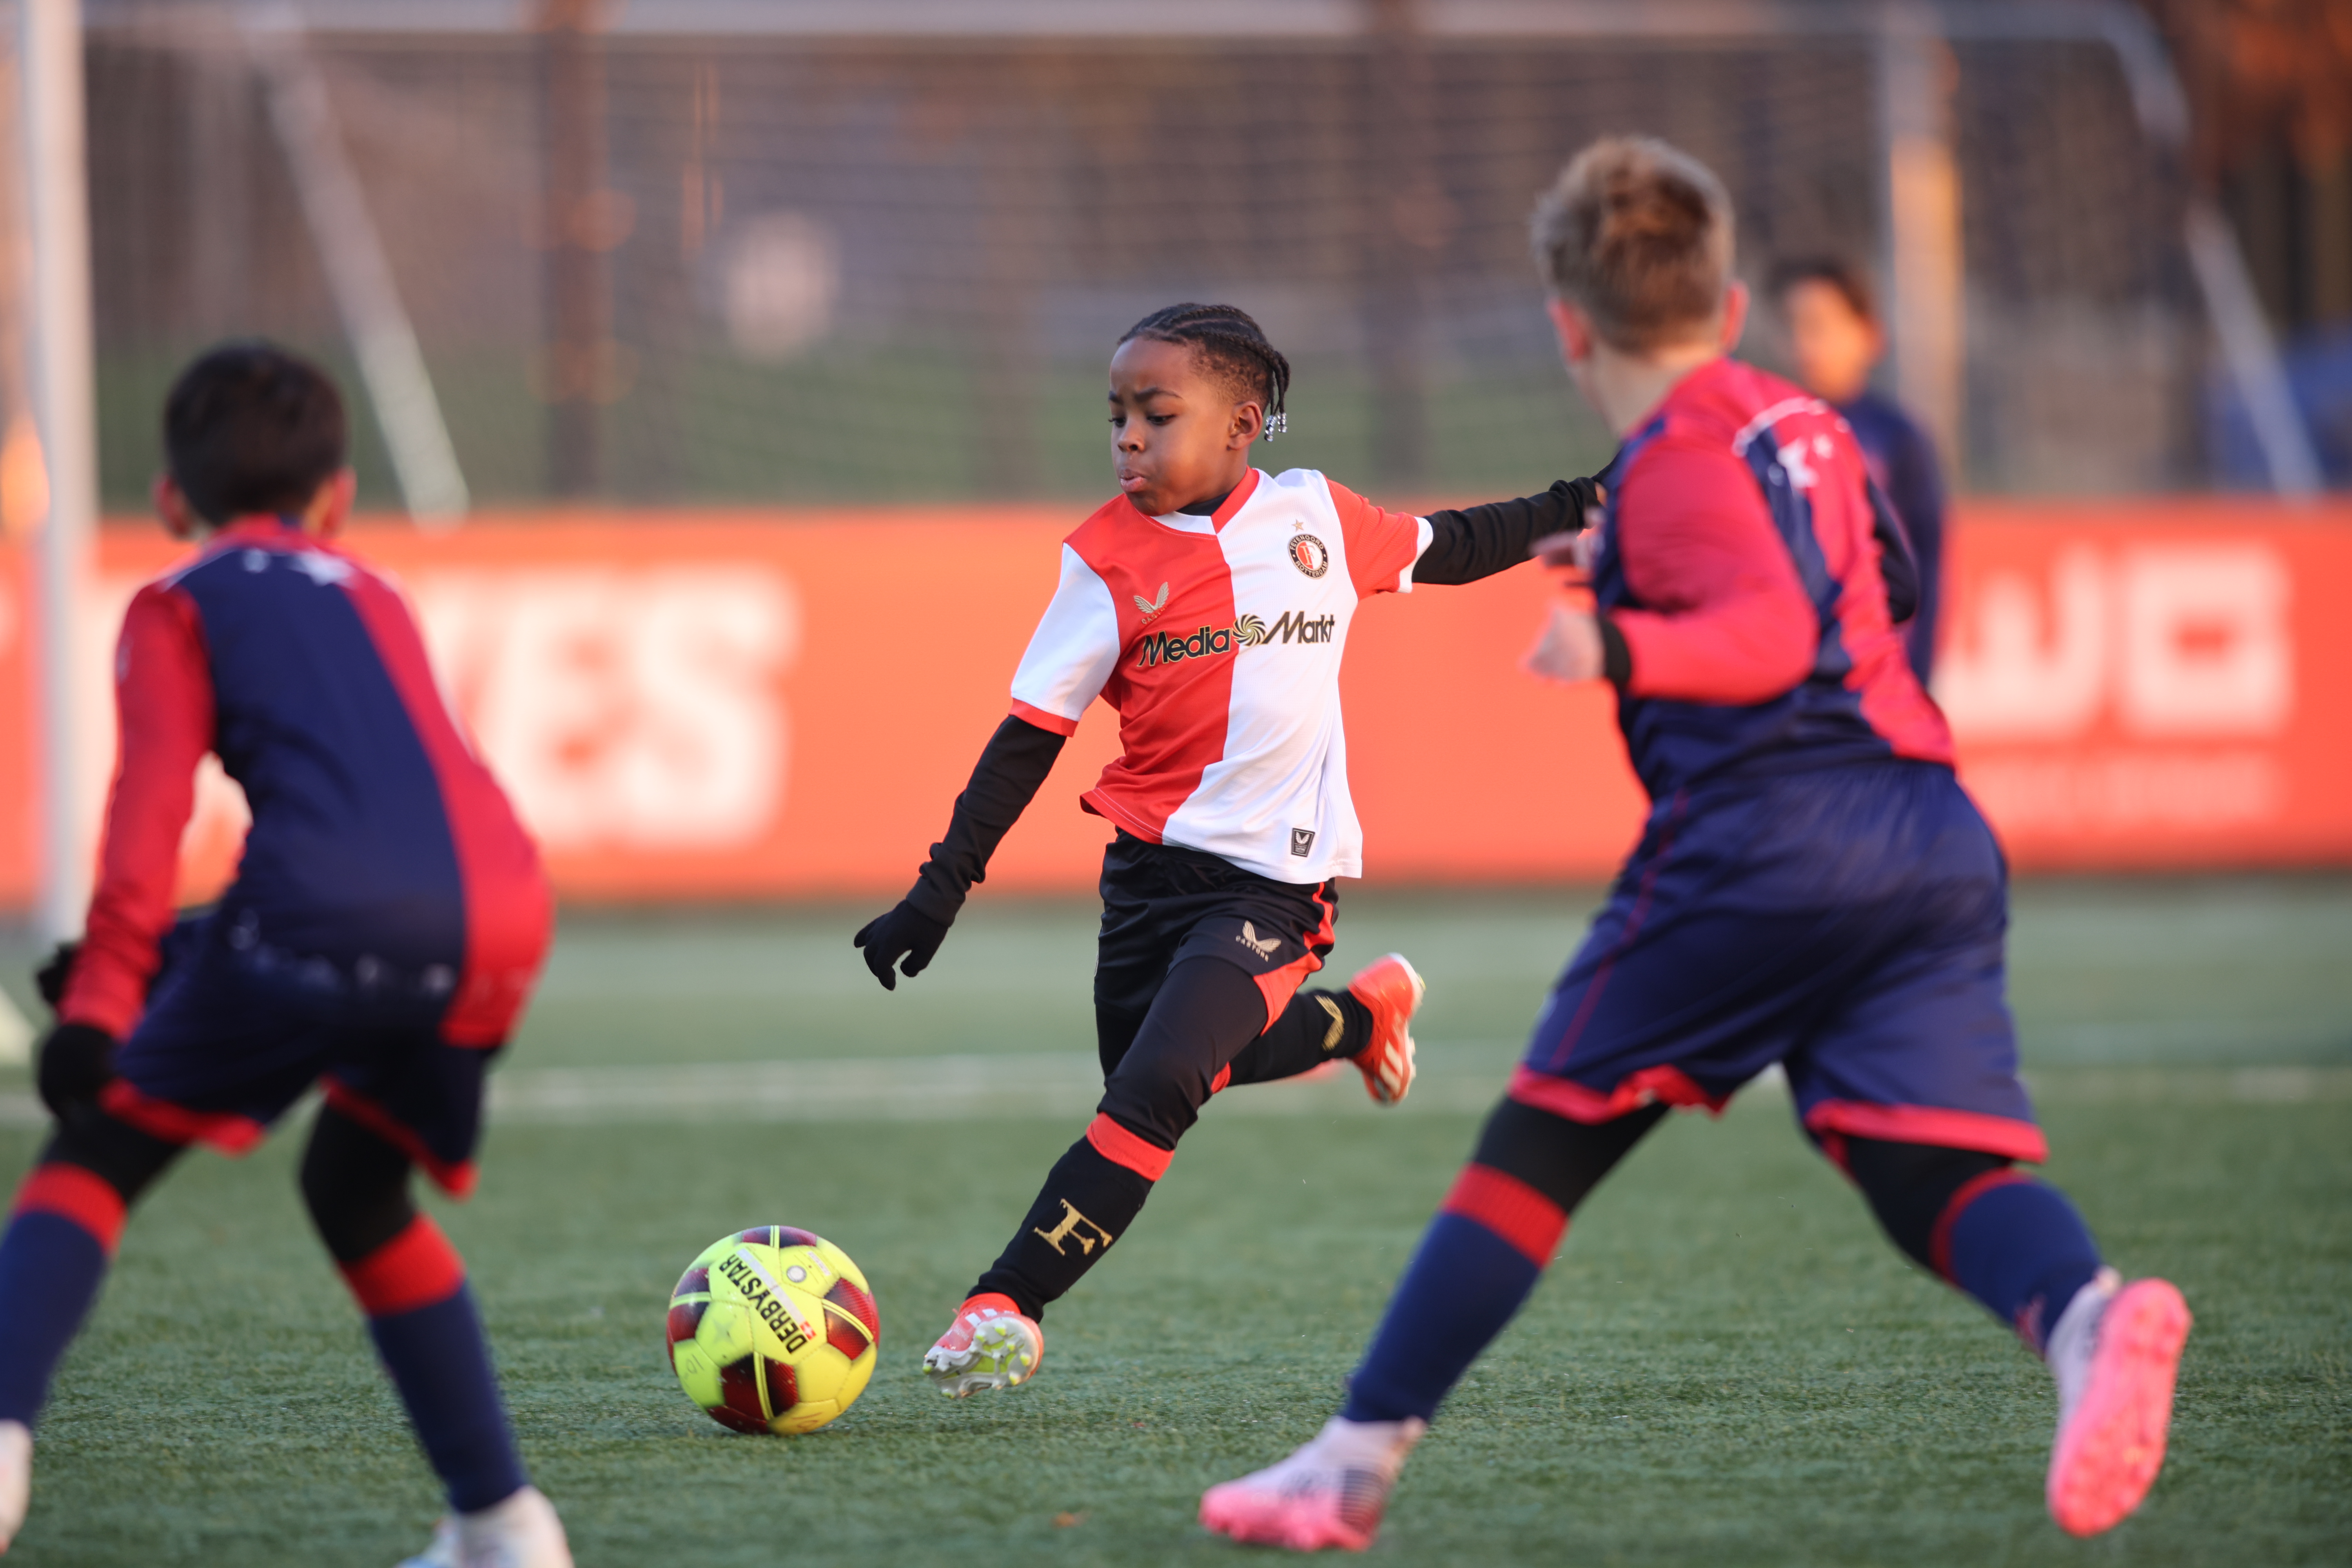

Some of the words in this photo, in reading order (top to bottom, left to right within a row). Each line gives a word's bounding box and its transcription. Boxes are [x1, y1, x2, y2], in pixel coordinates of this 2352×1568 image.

[1289, 535, 1324, 550] FEYENOORD
[1299, 545, 1316, 565] F
[1295, 561, 1328, 577] ROTTERDAM
[1136, 625, 1231, 667] Media
[1259, 610, 1335, 644] Markt
[1032, 1198, 1113, 1256] F
[719, 1254, 808, 1354] DERBYSTAR
